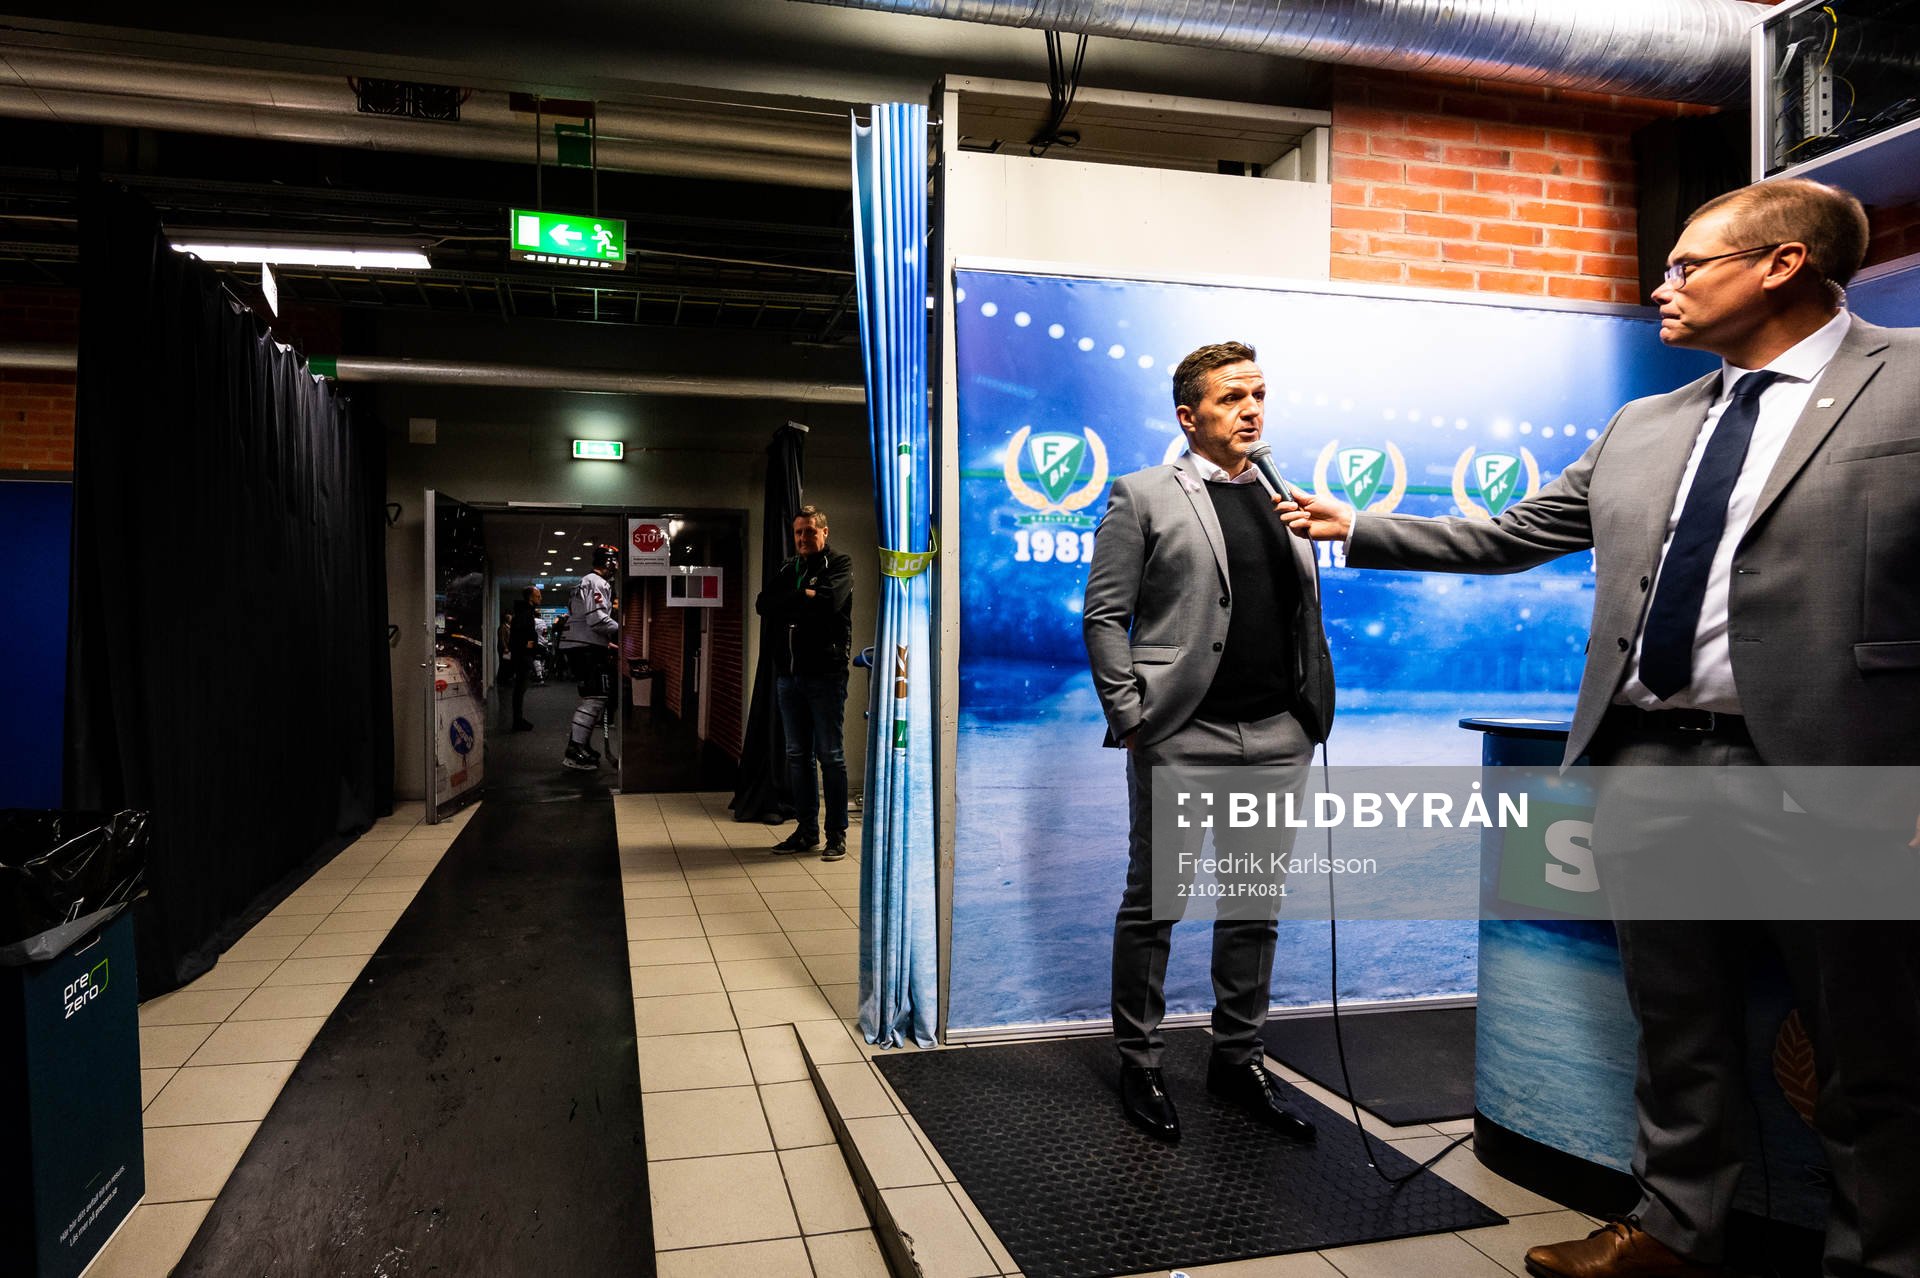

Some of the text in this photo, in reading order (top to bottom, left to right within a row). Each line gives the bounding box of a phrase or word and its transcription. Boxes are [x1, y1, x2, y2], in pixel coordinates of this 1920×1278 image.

[634, 533, 664, 543] STOP
[1014, 530, 1095, 563] 1981
[64, 973, 89, 1005] pre
[65, 985, 99, 1019] zero
